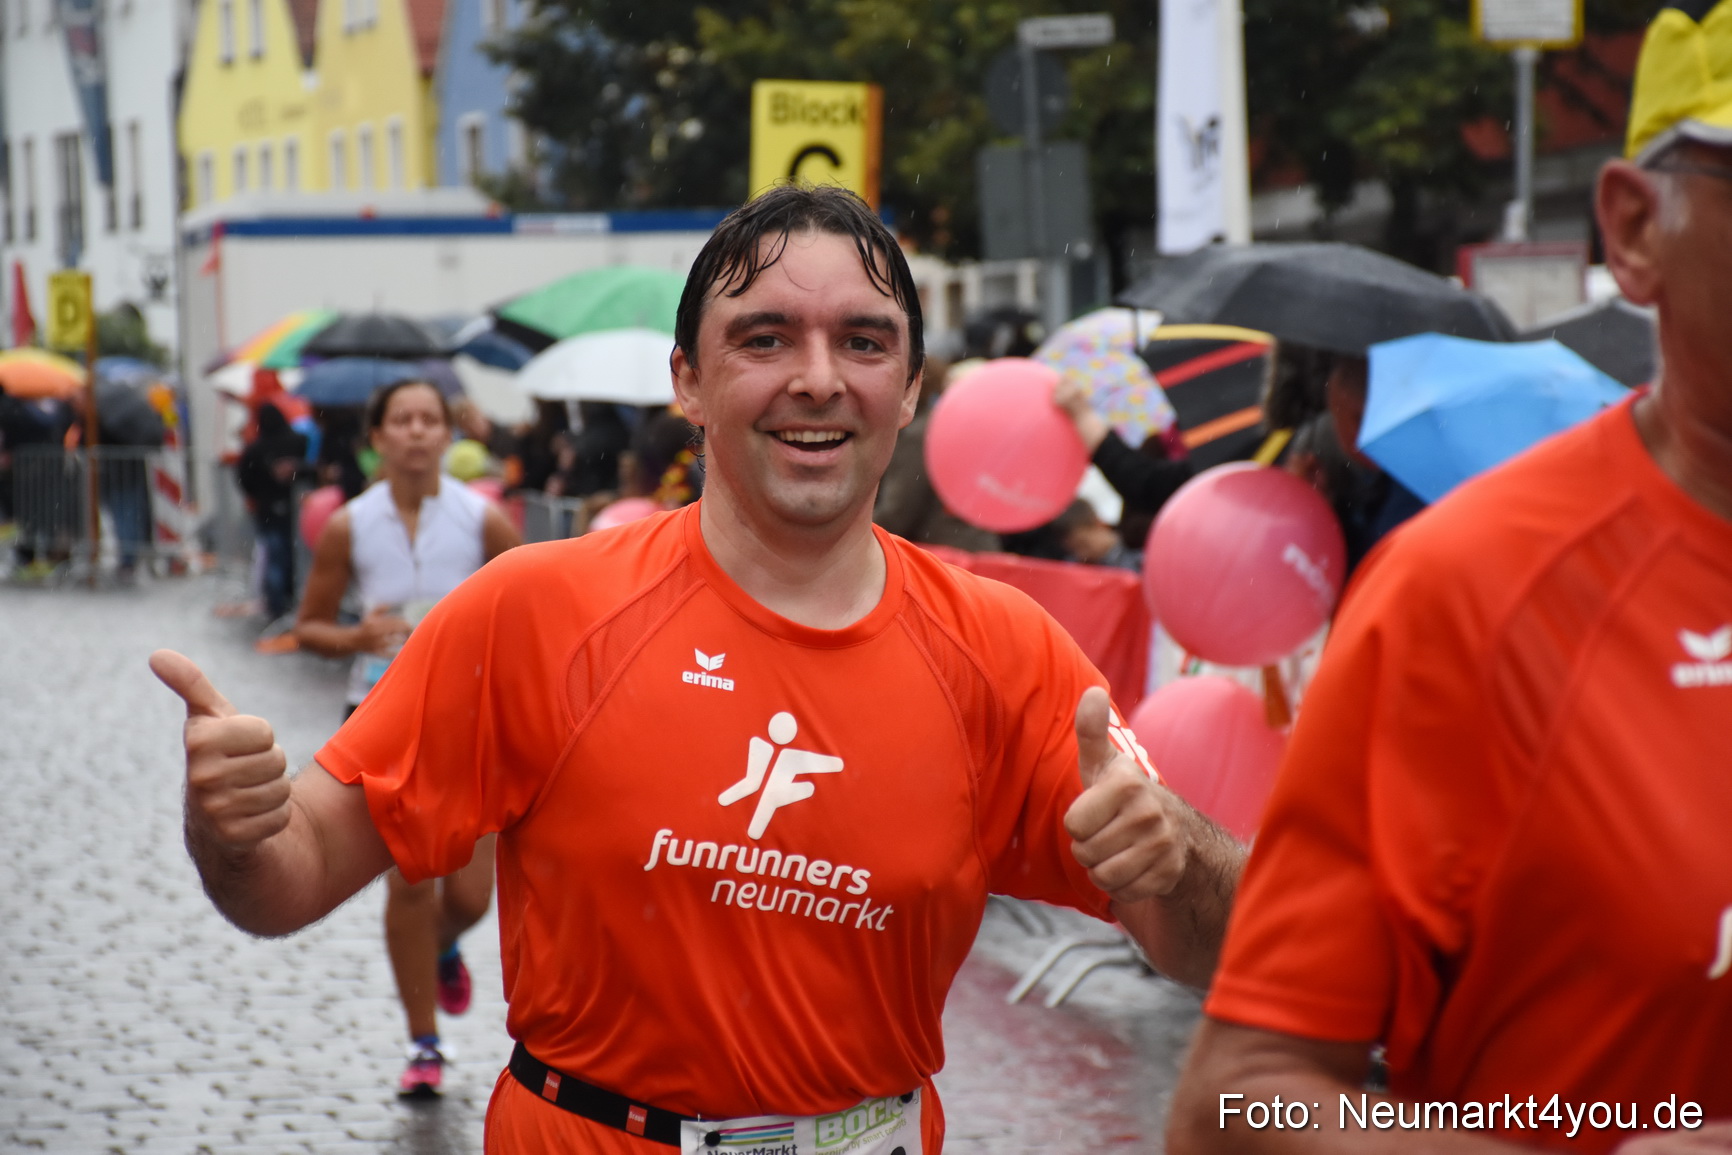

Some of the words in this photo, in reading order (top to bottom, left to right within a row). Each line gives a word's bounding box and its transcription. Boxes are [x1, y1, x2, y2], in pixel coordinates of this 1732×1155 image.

[769, 91, 865, 125] Block
[682, 670, 735, 692] erima
[643, 828, 871, 895] funrunners
[711, 879, 894, 931] neumarkt
[816, 1095, 903, 1147] BOCK
[862, 1130, 885, 1144] smart
